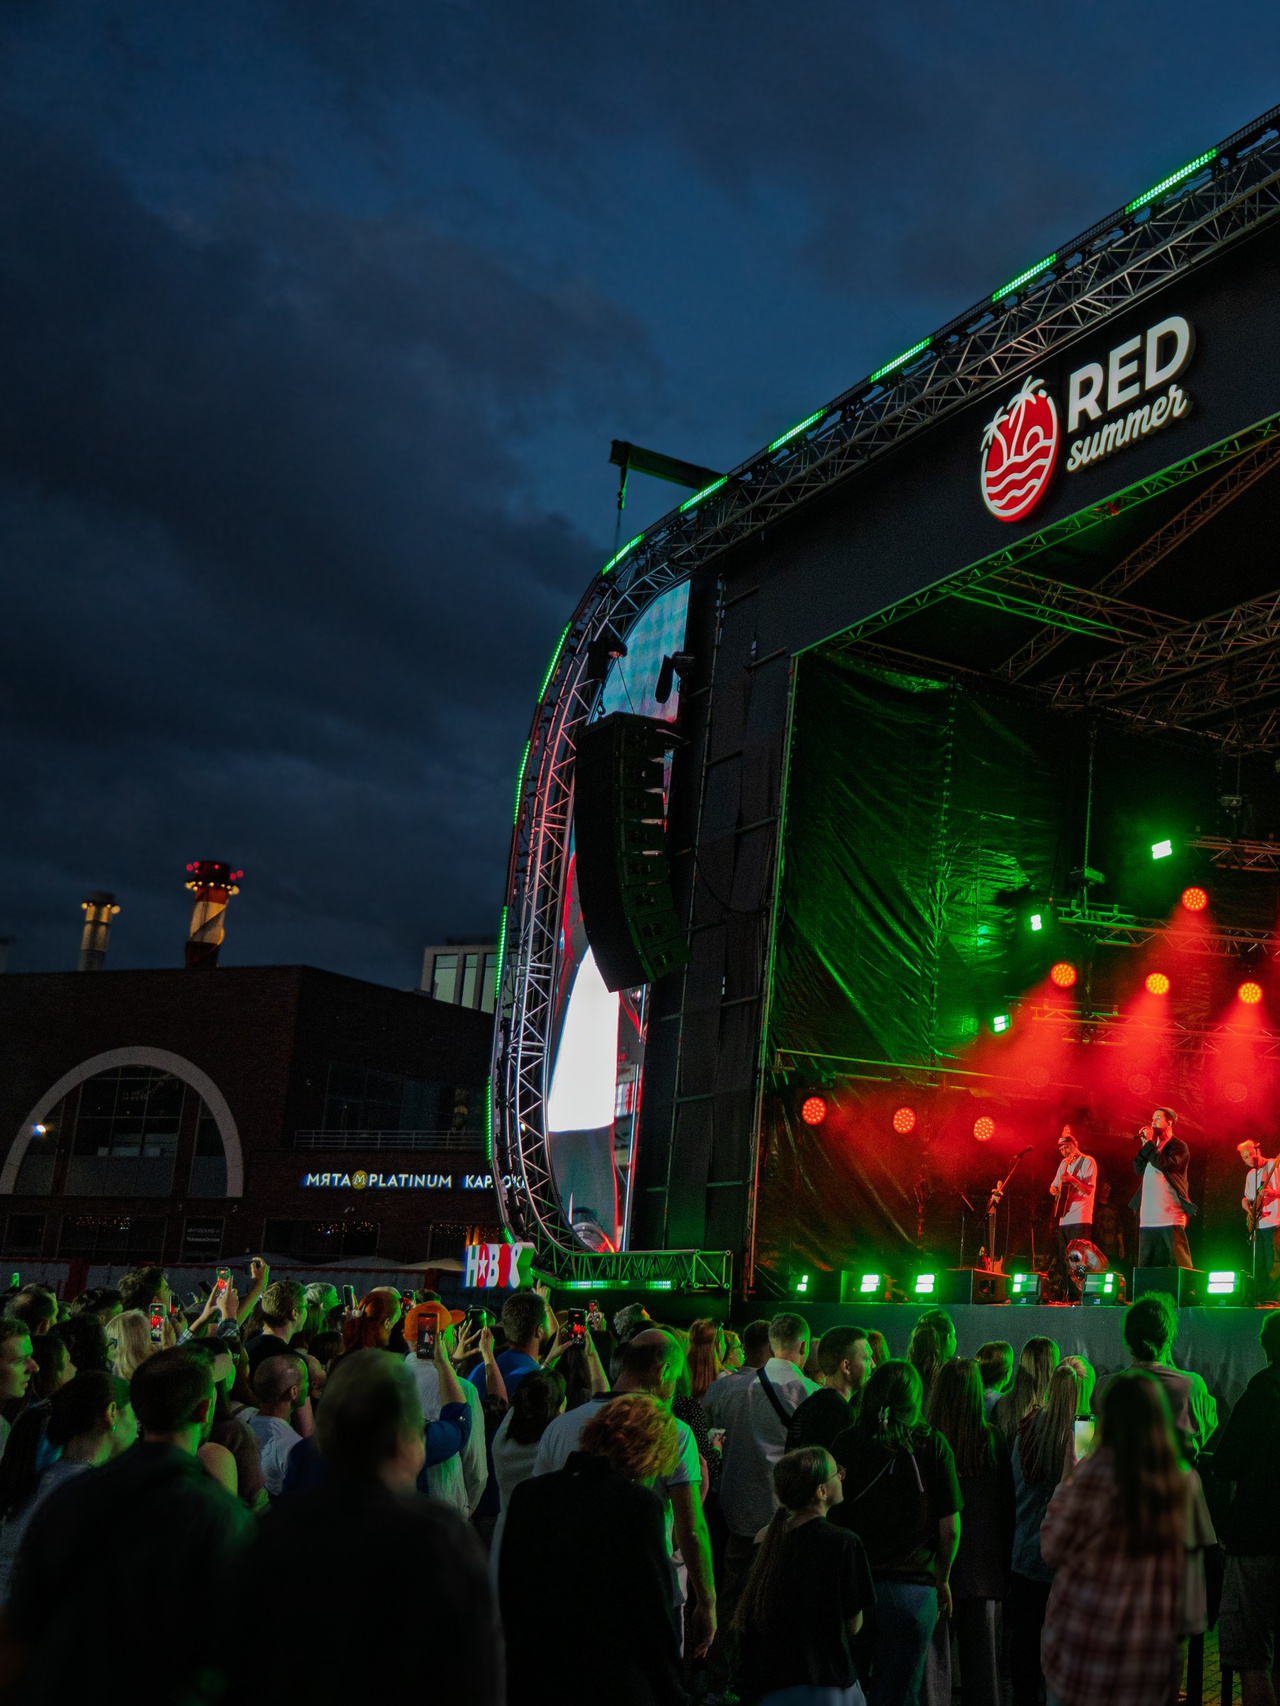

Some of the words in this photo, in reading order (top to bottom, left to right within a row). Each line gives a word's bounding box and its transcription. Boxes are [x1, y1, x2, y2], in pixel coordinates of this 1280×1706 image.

[1068, 316, 1190, 433] RED
[1067, 384, 1187, 472] summer
[306, 1173, 351, 1186] МЯТА
[368, 1174, 452, 1188] PLATINUM
